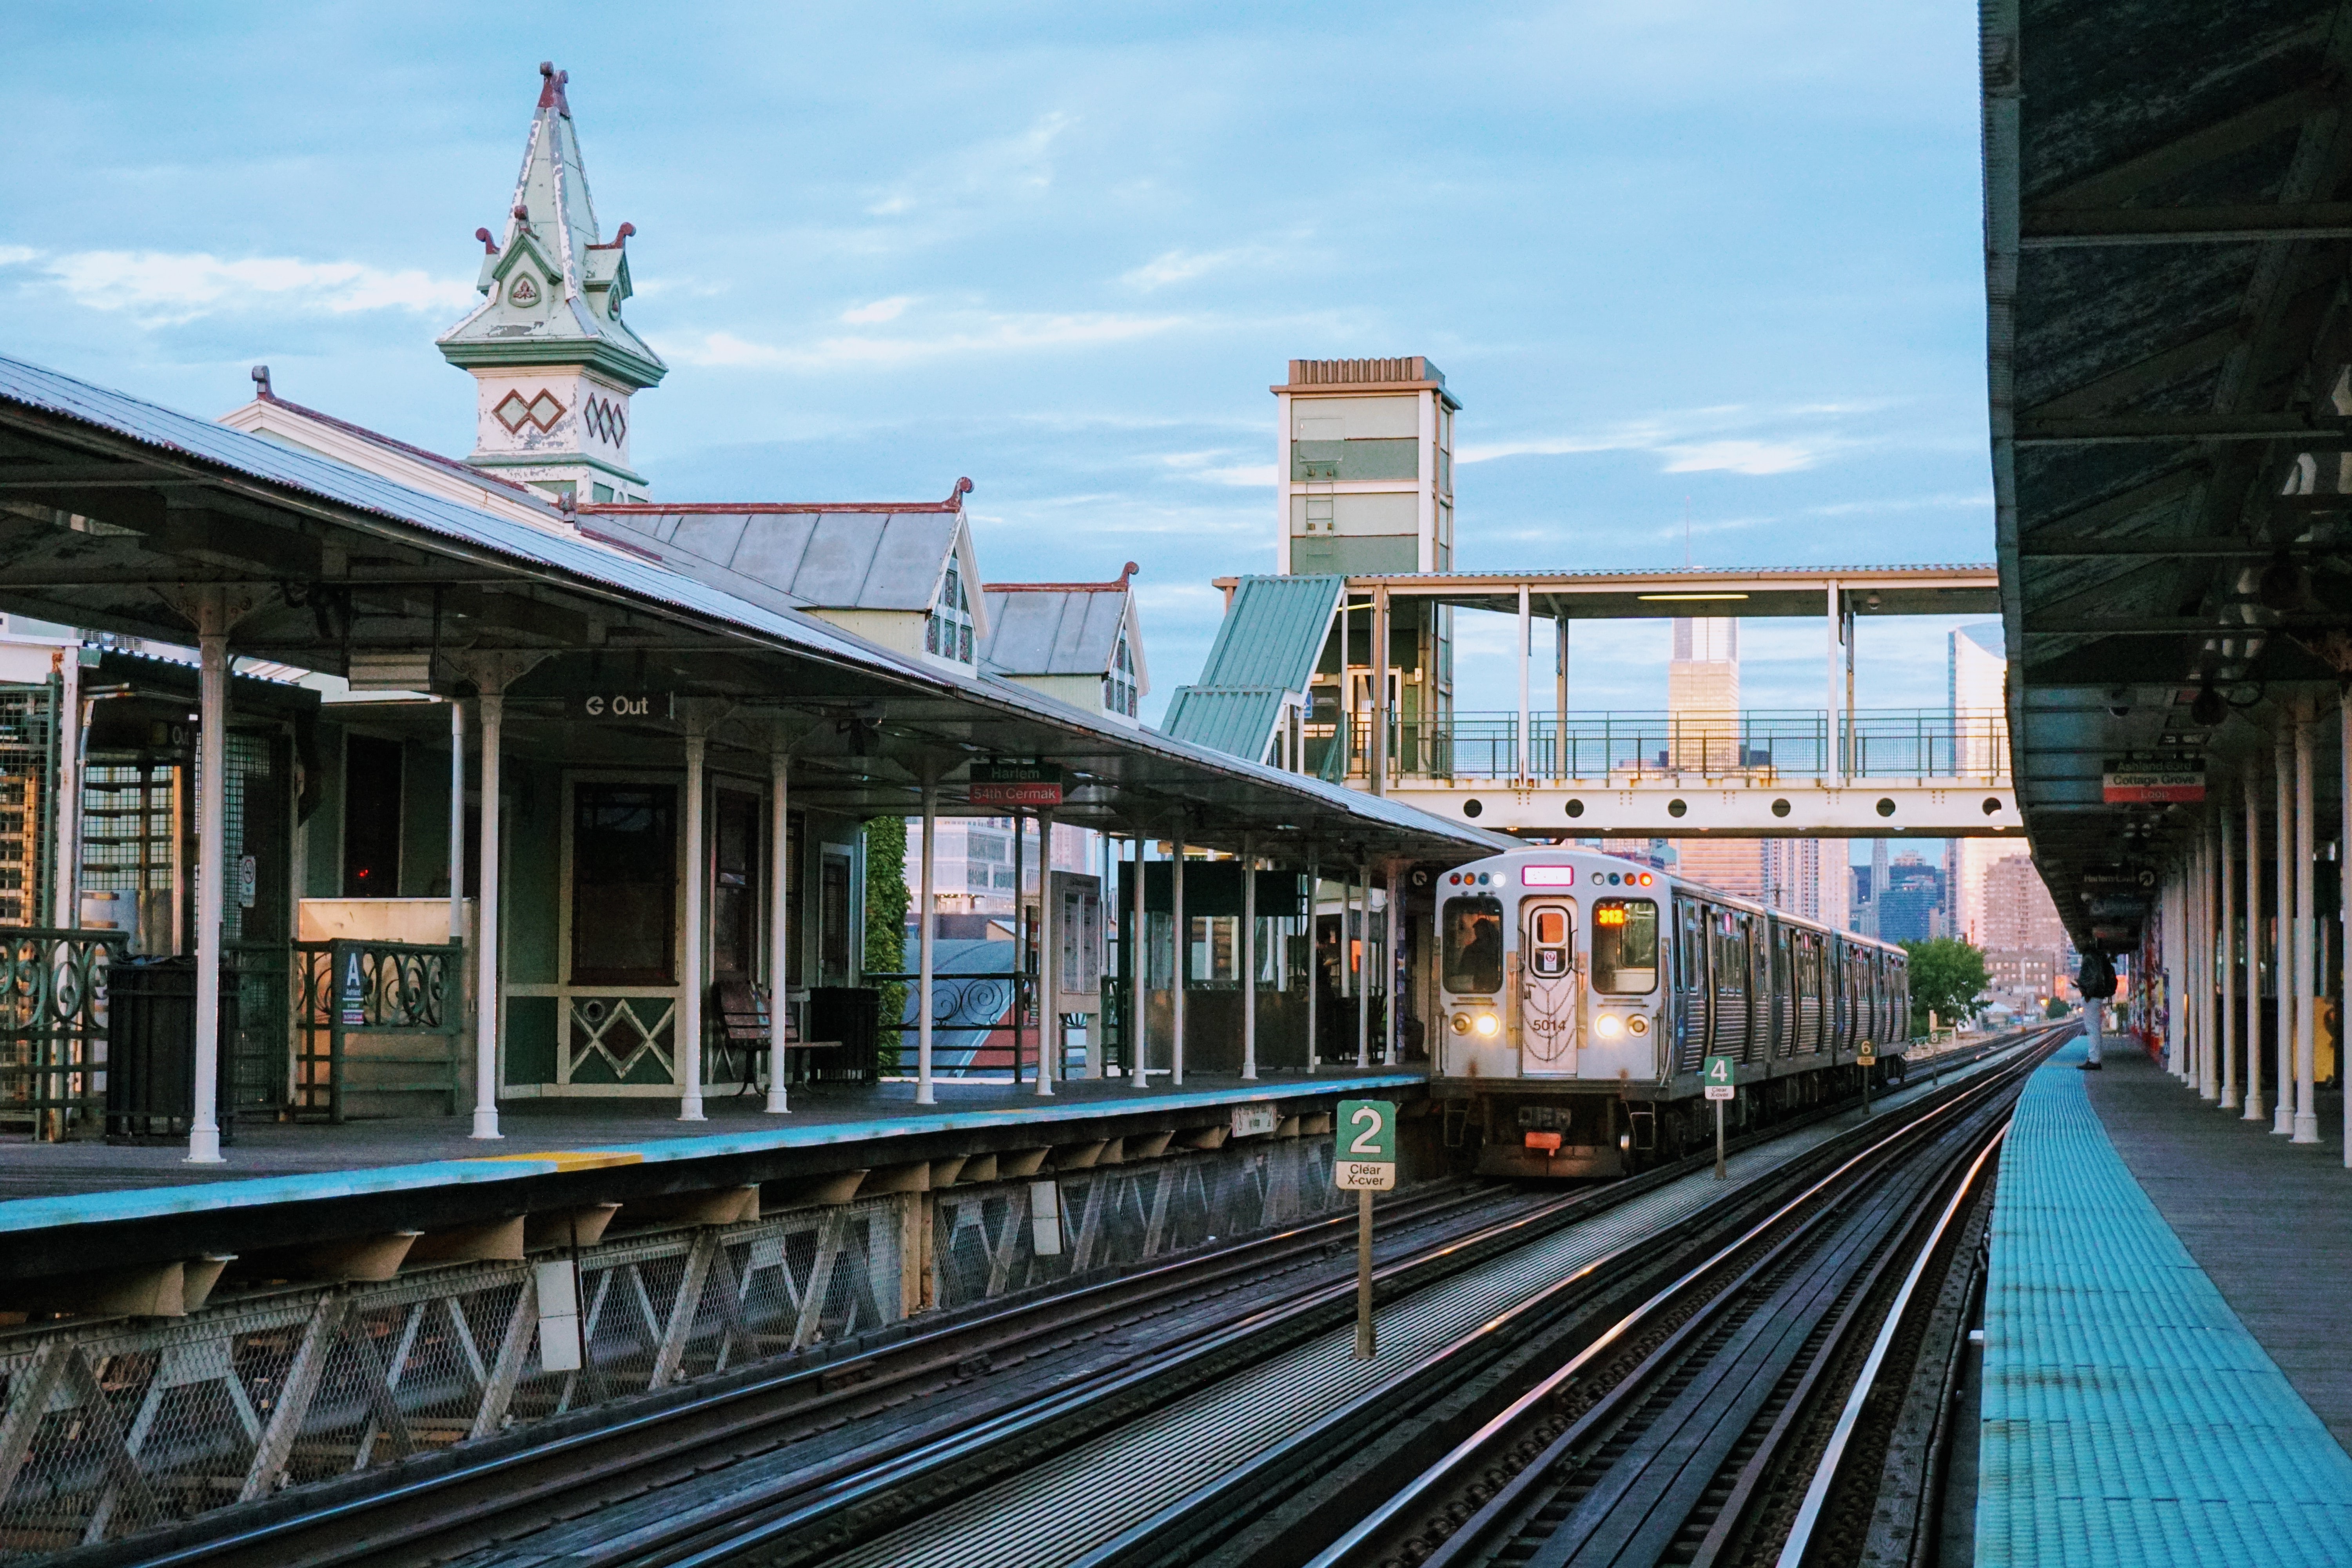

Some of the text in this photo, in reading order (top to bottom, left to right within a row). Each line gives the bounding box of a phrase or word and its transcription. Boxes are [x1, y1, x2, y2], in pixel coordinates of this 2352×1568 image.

[612, 695, 648, 715] Out
[992, 767, 1040, 779] Harlem
[2114, 774, 2196, 787] Cottage Grove
[1599, 909, 1624, 923] 312
[347, 953, 360, 986] A
[1534, 1020, 1566, 1031] 5014
[1931, 1033, 1938, 1043] 8
[1861, 1041, 1871, 1054] 6
[1711, 1060, 1727, 1082] 4
[1350, 1108, 1382, 1154] 2
[1350, 1164, 1381, 1174] Clear
